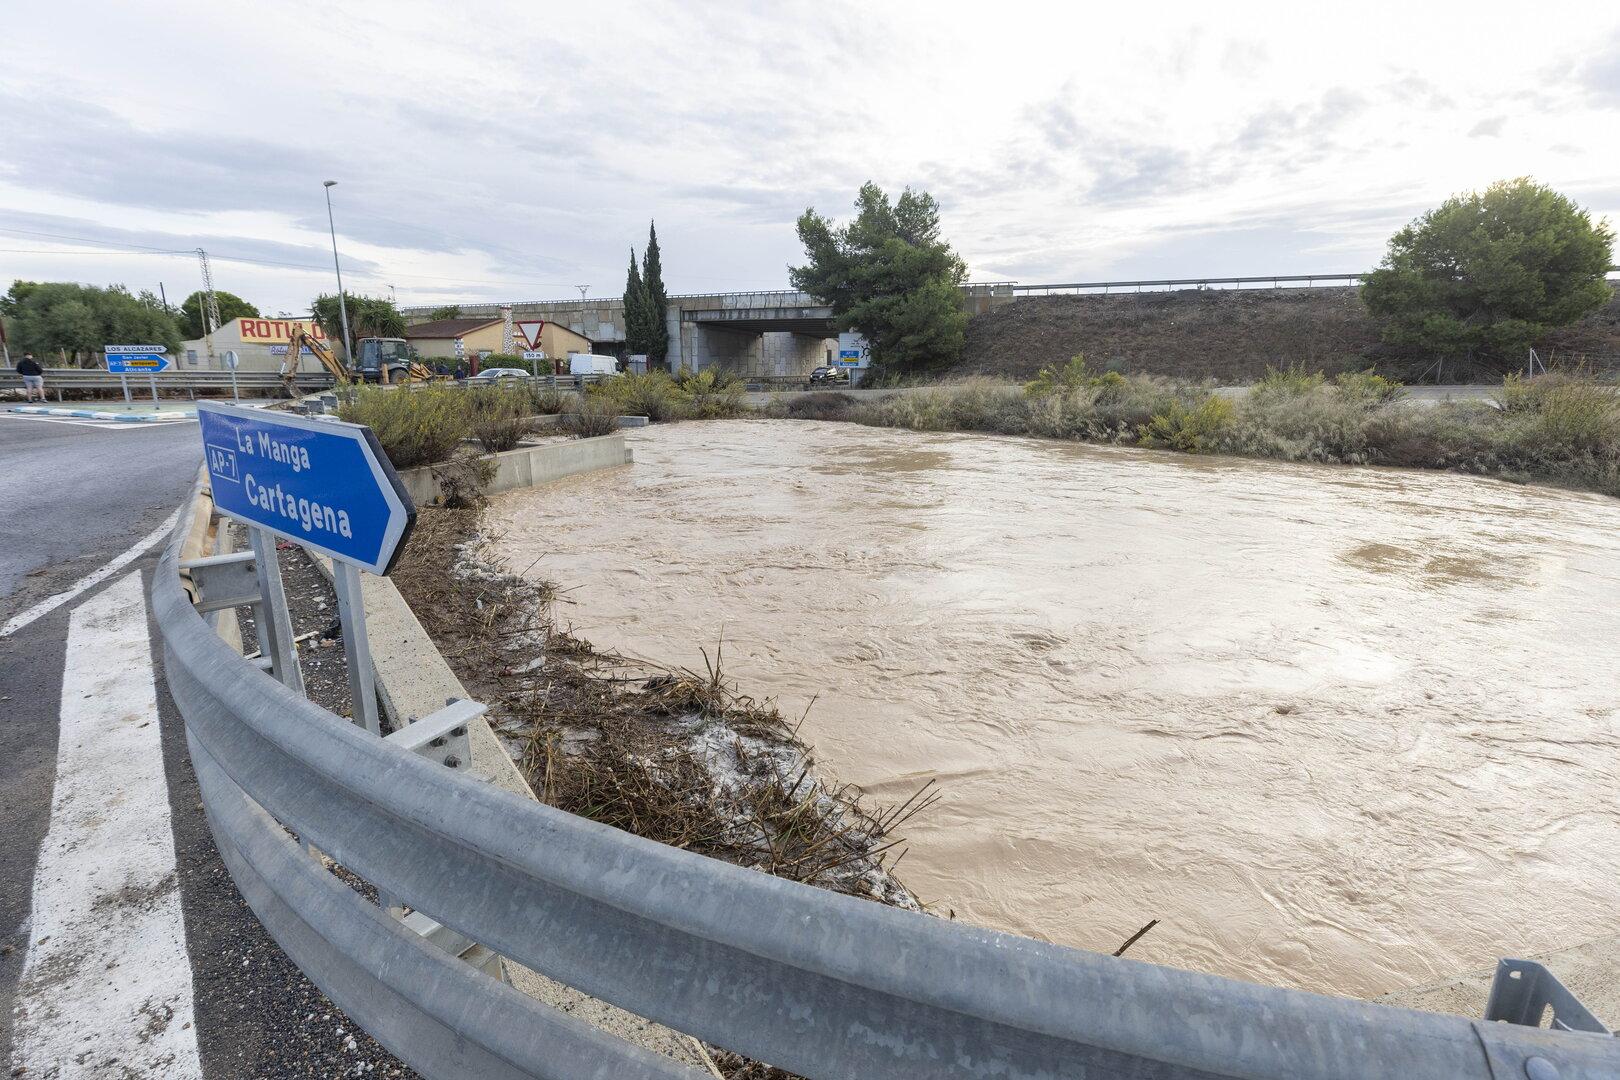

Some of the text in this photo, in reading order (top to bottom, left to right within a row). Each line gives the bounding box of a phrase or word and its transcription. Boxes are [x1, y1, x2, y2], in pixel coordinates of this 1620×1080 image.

[210, 449, 237, 477] AP-7
[235, 427, 311, 473] La Manga
[245, 473, 353, 540] Cartagena
